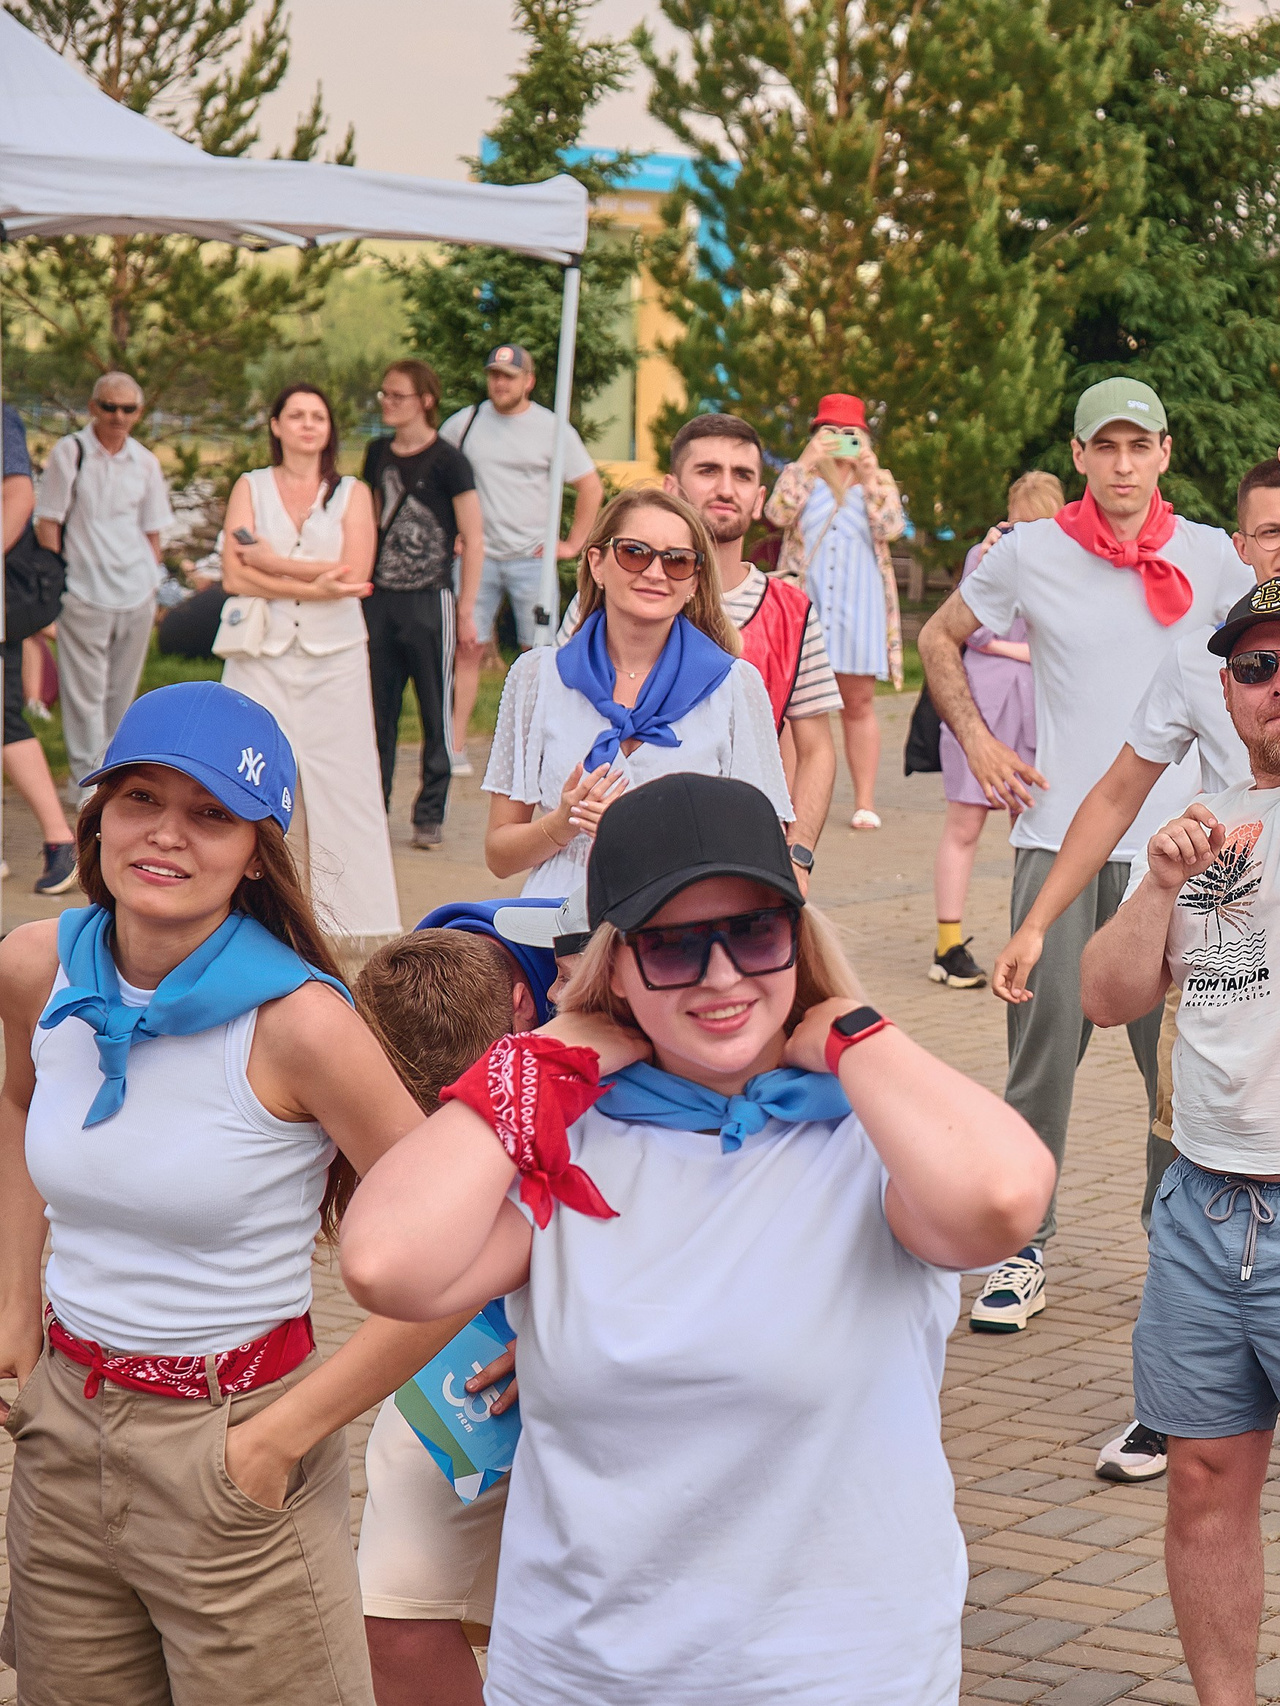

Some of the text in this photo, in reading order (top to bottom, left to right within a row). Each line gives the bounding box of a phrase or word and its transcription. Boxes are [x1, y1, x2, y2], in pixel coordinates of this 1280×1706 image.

[237, 747, 266, 786] NY
[1187, 979, 1219, 991] TOM
[455, 1412, 474, 1433] лет
